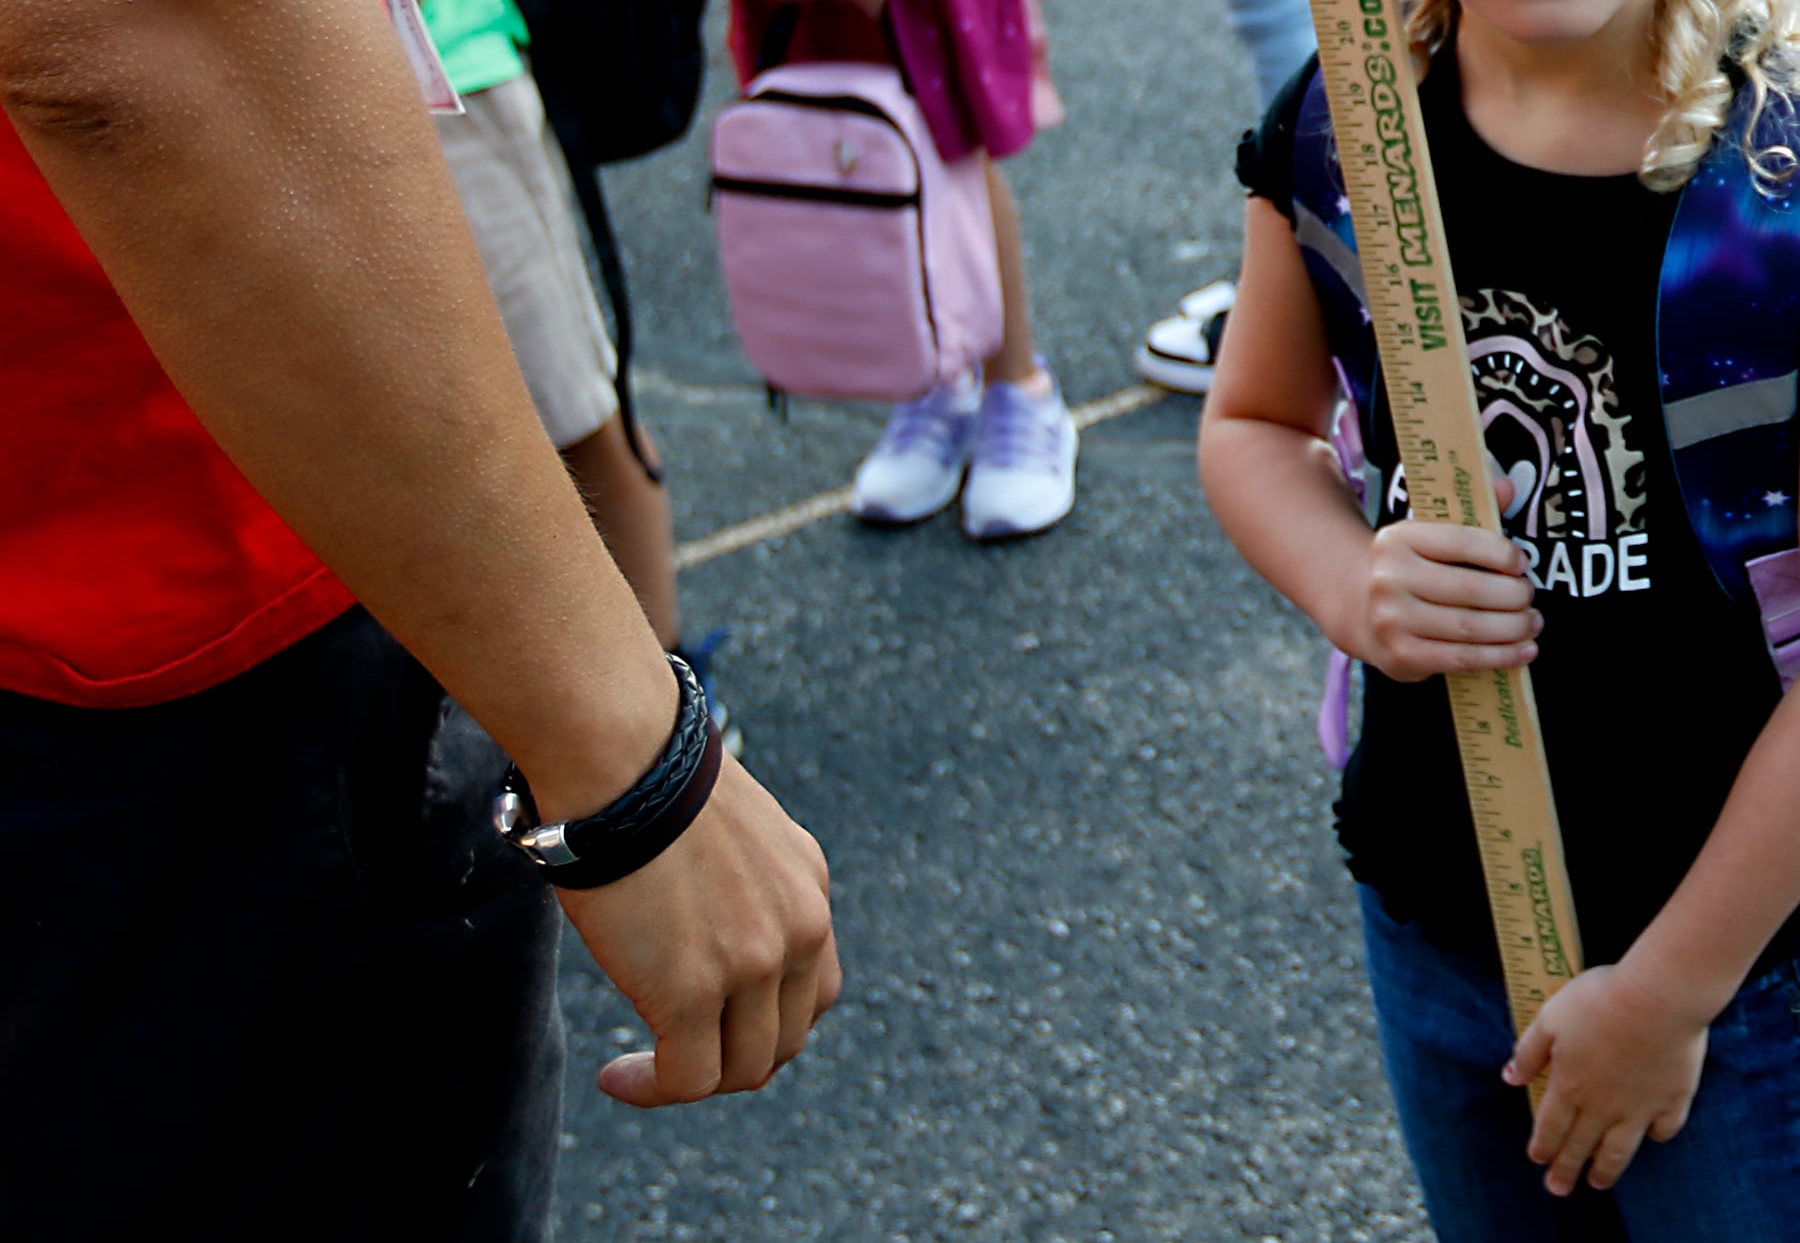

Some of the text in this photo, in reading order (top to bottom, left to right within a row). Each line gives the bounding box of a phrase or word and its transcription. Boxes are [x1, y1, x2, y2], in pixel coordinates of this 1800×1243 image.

[1337, 21, 1353, 43] 20
[1350, 82, 1365, 104] 19
[1361, 144, 1377, 165] 18
[1373, 204, 1389, 226] 17
[1386, 264, 1402, 285] 16
[1408, 278, 1447, 352] VISIT
[1397, 323, 1413, 344] 15
[1410, 382, 1426, 402] 14
[1421, 440, 1437, 460] 13
[1433, 497, 1448, 517] 12
[1508, 533, 1651, 598] RADE
[1455, 467, 1522, 749] Dedicate uality
[1522, 847, 1564, 976] MENARDS
